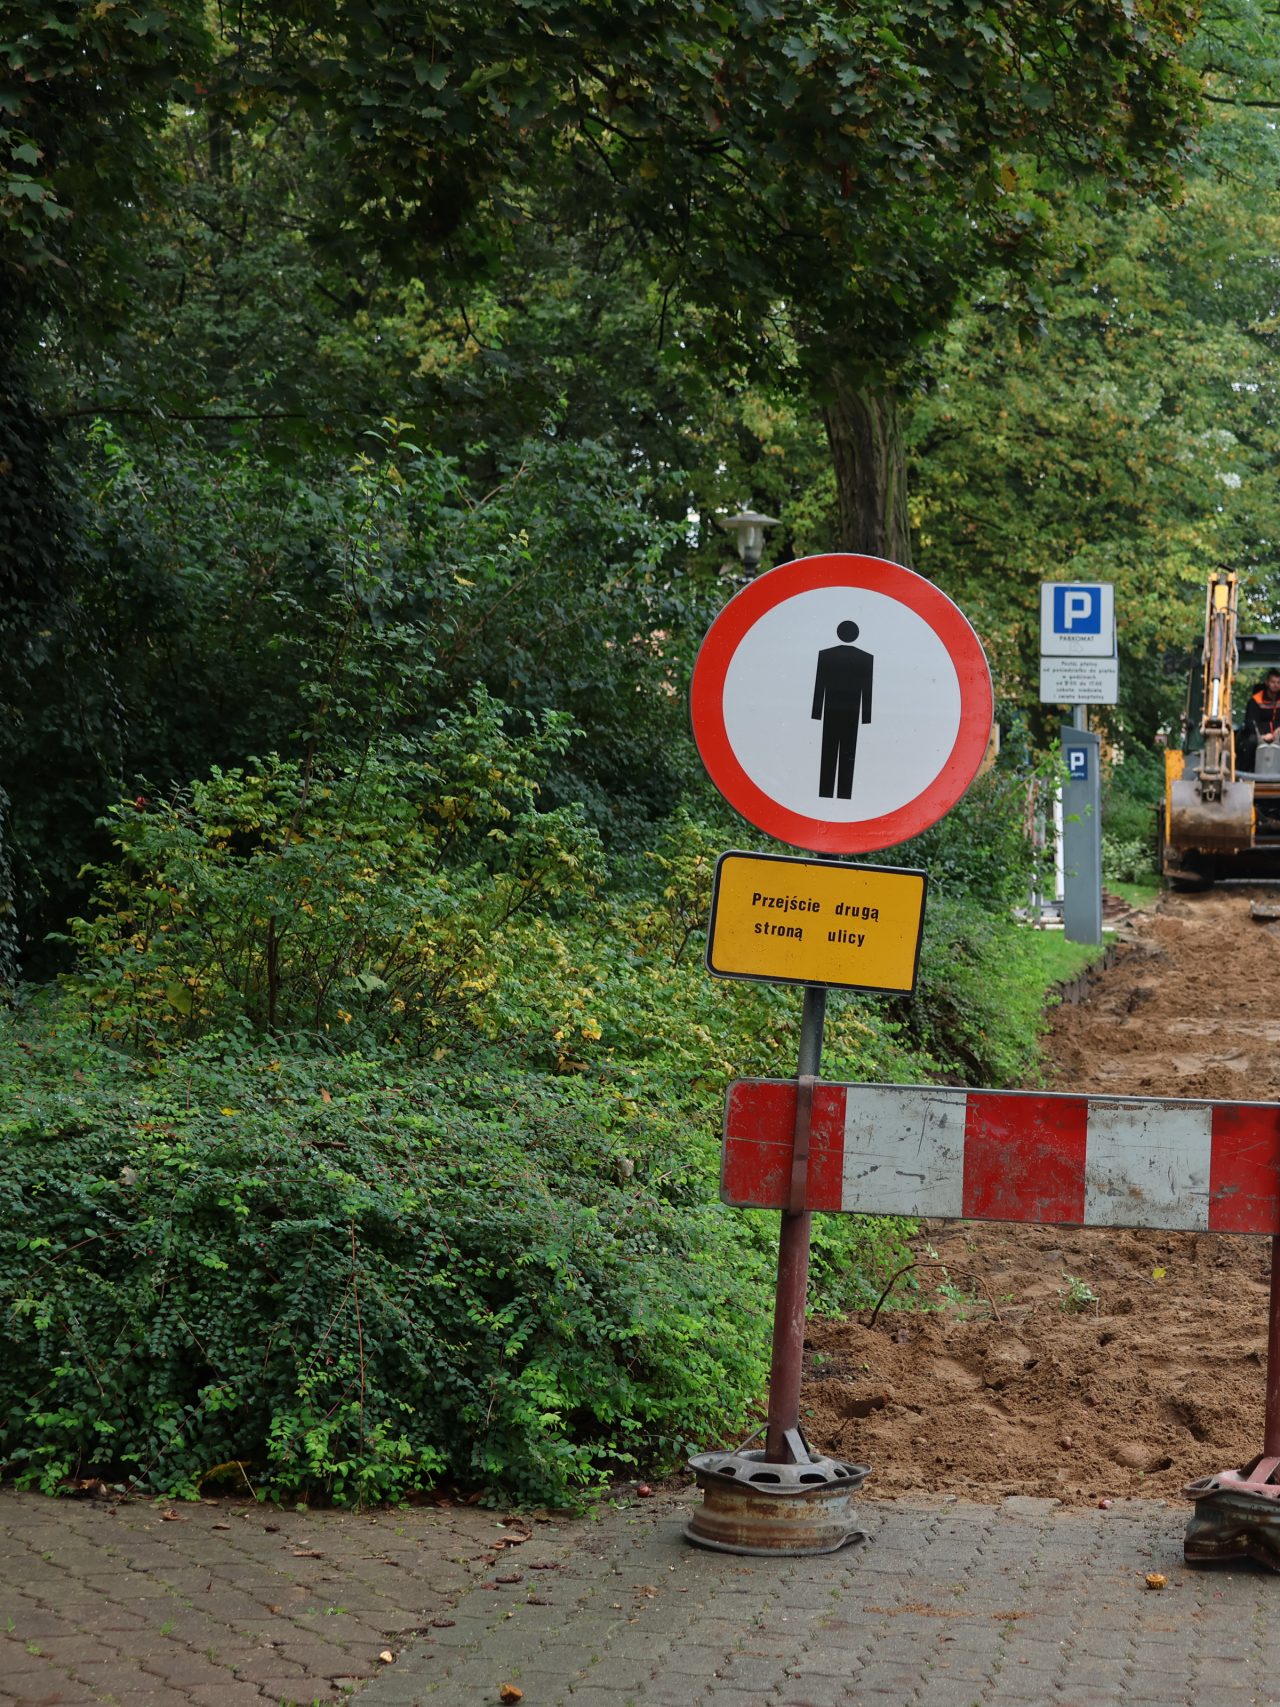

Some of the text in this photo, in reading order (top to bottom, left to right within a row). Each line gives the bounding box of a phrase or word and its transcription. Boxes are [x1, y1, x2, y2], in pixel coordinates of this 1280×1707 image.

[1064, 591, 1092, 629] P
[1070, 752, 1085, 771] P
[752, 892, 879, 922] Przejście drugą
[754, 922, 865, 947] stroną ulicy
